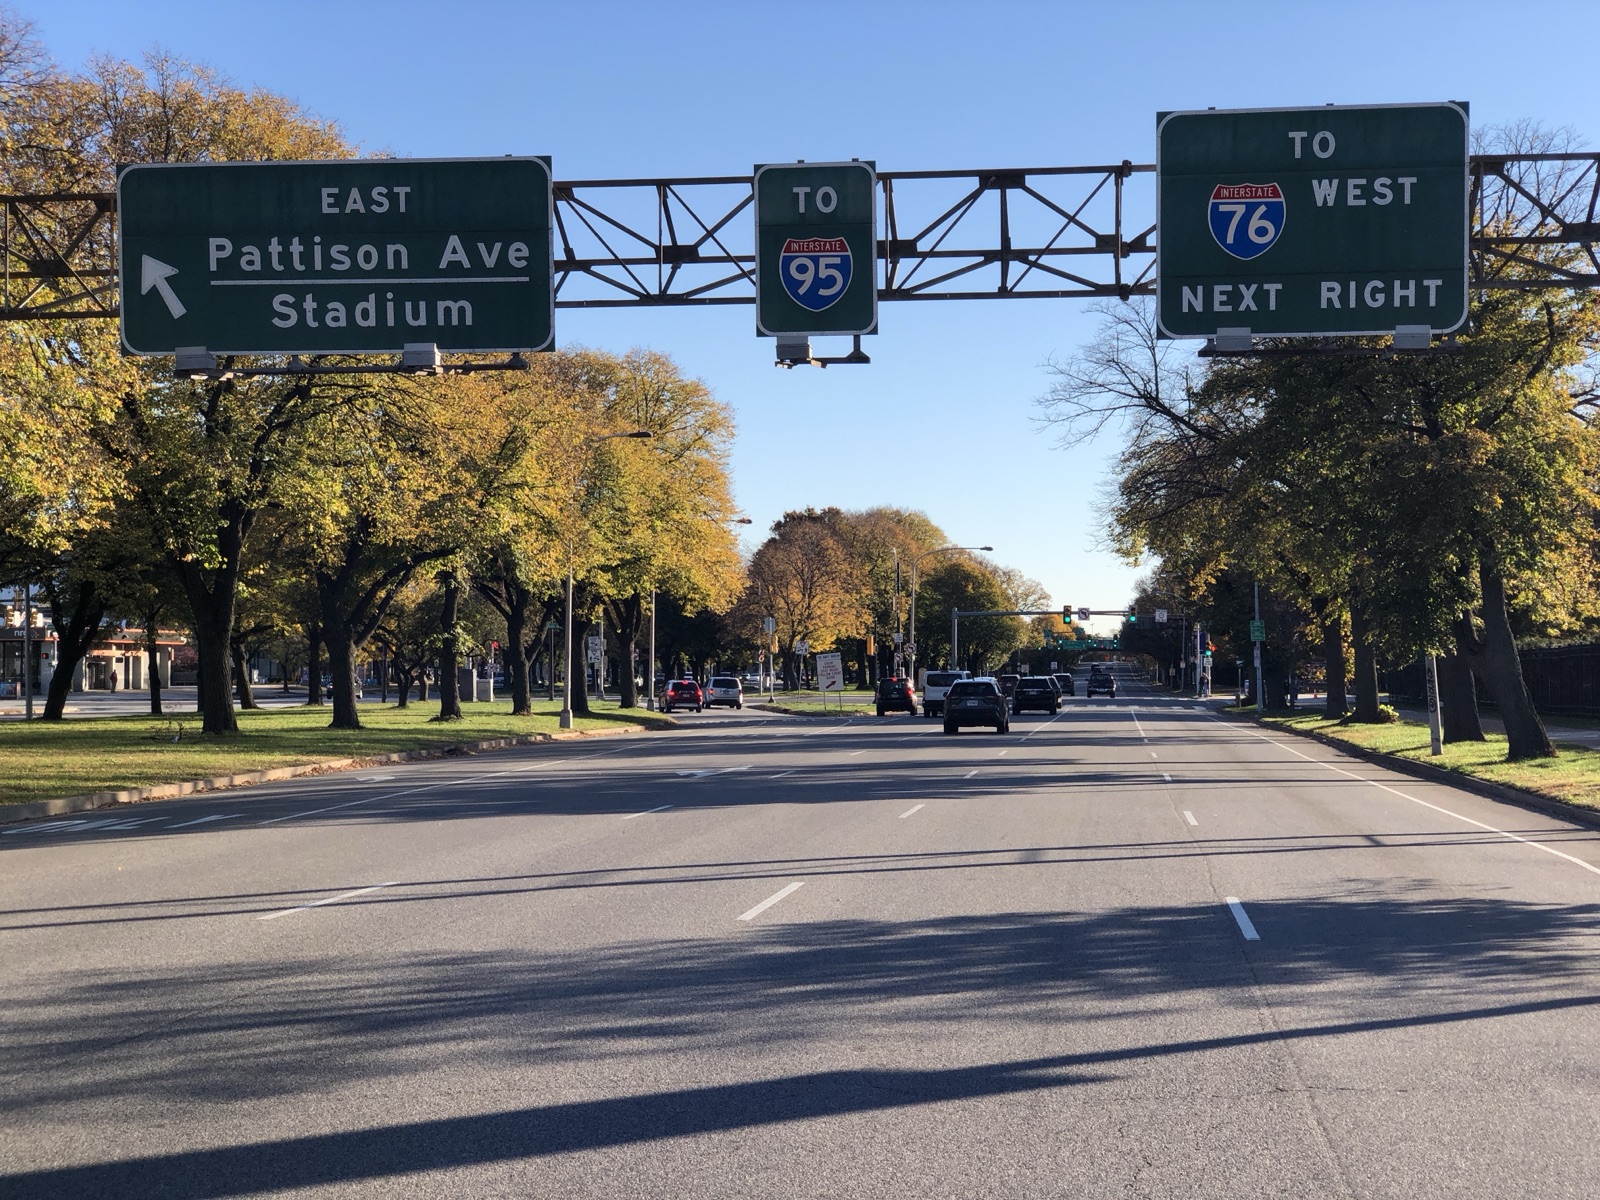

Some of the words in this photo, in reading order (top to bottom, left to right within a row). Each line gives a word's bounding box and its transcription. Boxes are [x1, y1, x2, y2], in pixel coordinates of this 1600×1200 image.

[1288, 130, 1336, 159] TO
[321, 186, 411, 214] EAST
[792, 186, 838, 213] TO
[1220, 187, 1274, 198] INTERSTATE
[1311, 176, 1418, 207] WEST
[1218, 204, 1276, 245] 76
[209, 235, 408, 272] Pattison
[438, 235, 530, 269] Ave
[790, 241, 841, 252] INTERSTATE
[789, 256, 844, 297] 95
[271, 291, 473, 328] Stadium
[1182, 283, 1283, 313] NEXT
[1320, 278, 1443, 309] RIGHT
